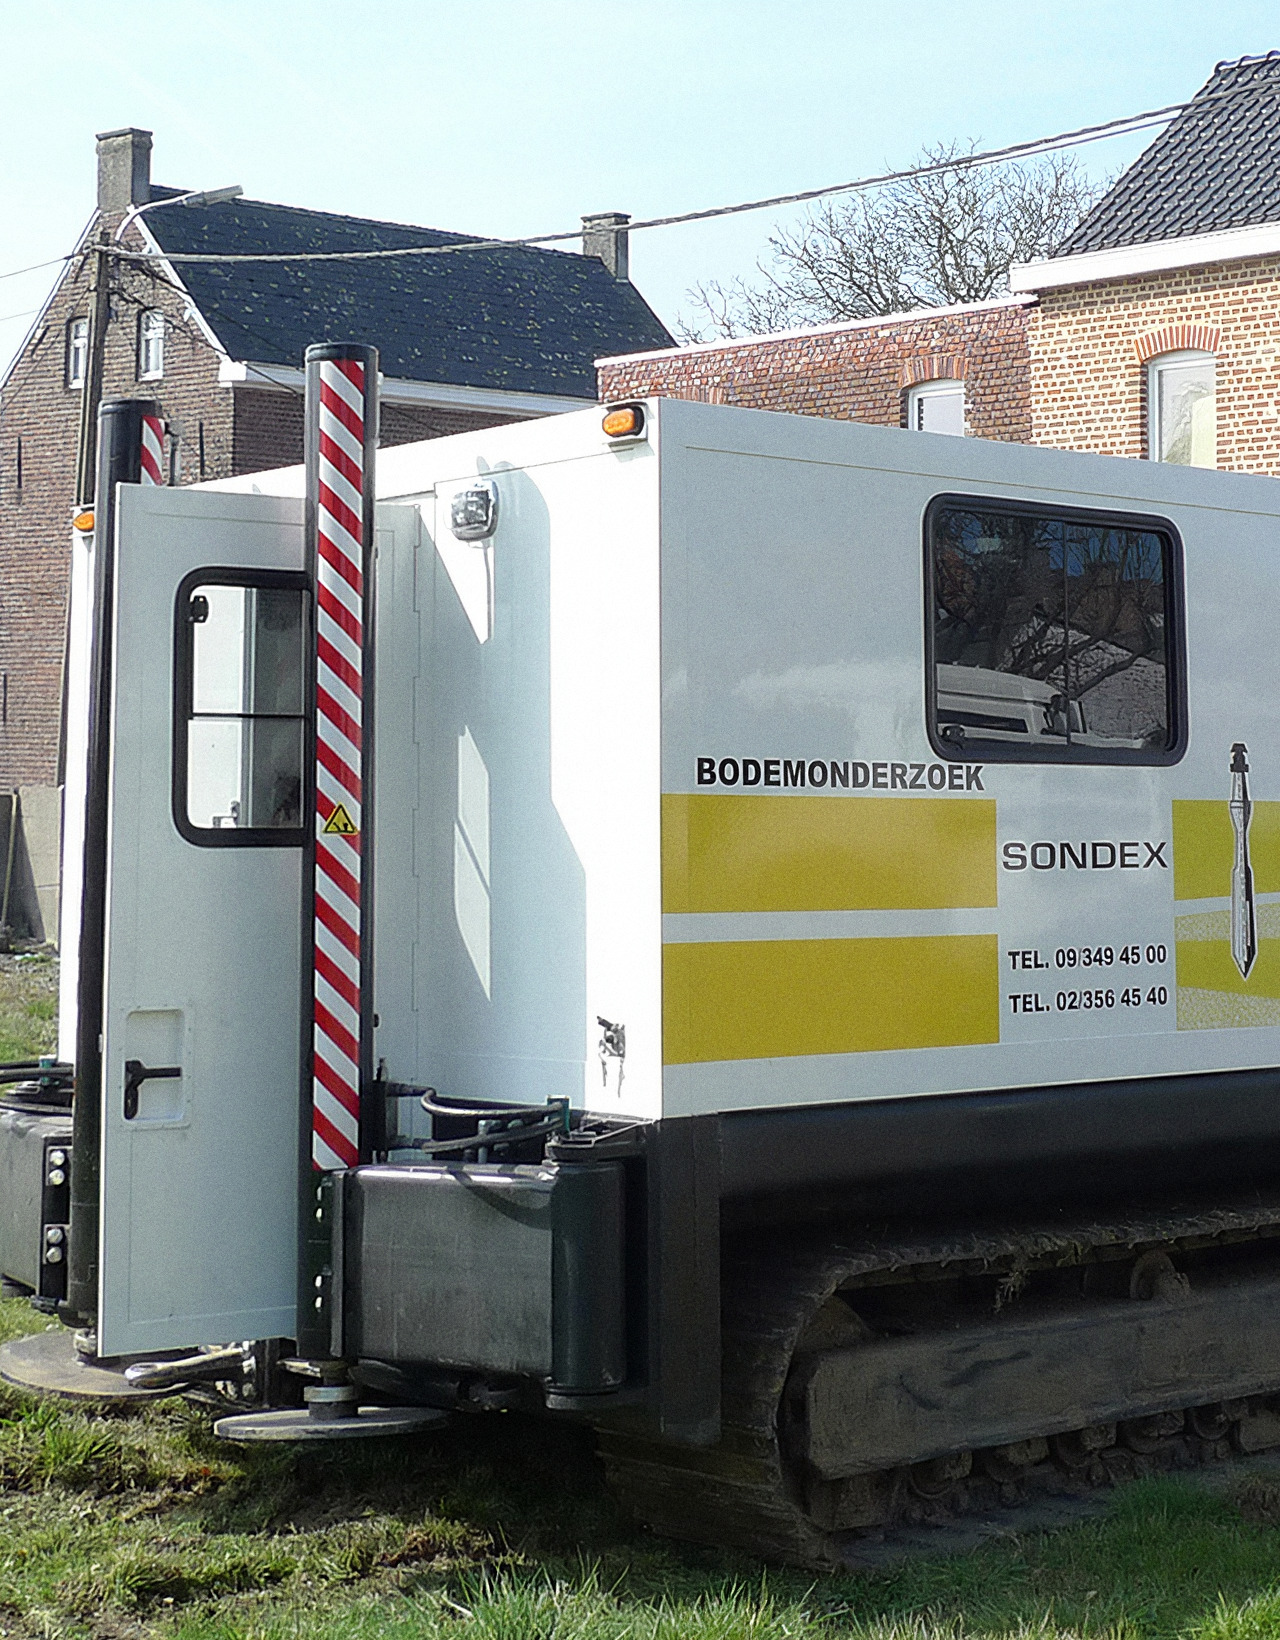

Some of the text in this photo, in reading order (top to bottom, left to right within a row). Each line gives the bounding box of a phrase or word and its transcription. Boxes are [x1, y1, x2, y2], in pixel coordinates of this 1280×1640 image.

[696, 757, 985, 791] BODEMONDERZOEK
[1001, 841, 1168, 871] SONDEX
[1007, 944, 1167, 970] TEL. 09/349 45 00
[1008, 986, 1168, 1014] TEL. 02/356 45 40
